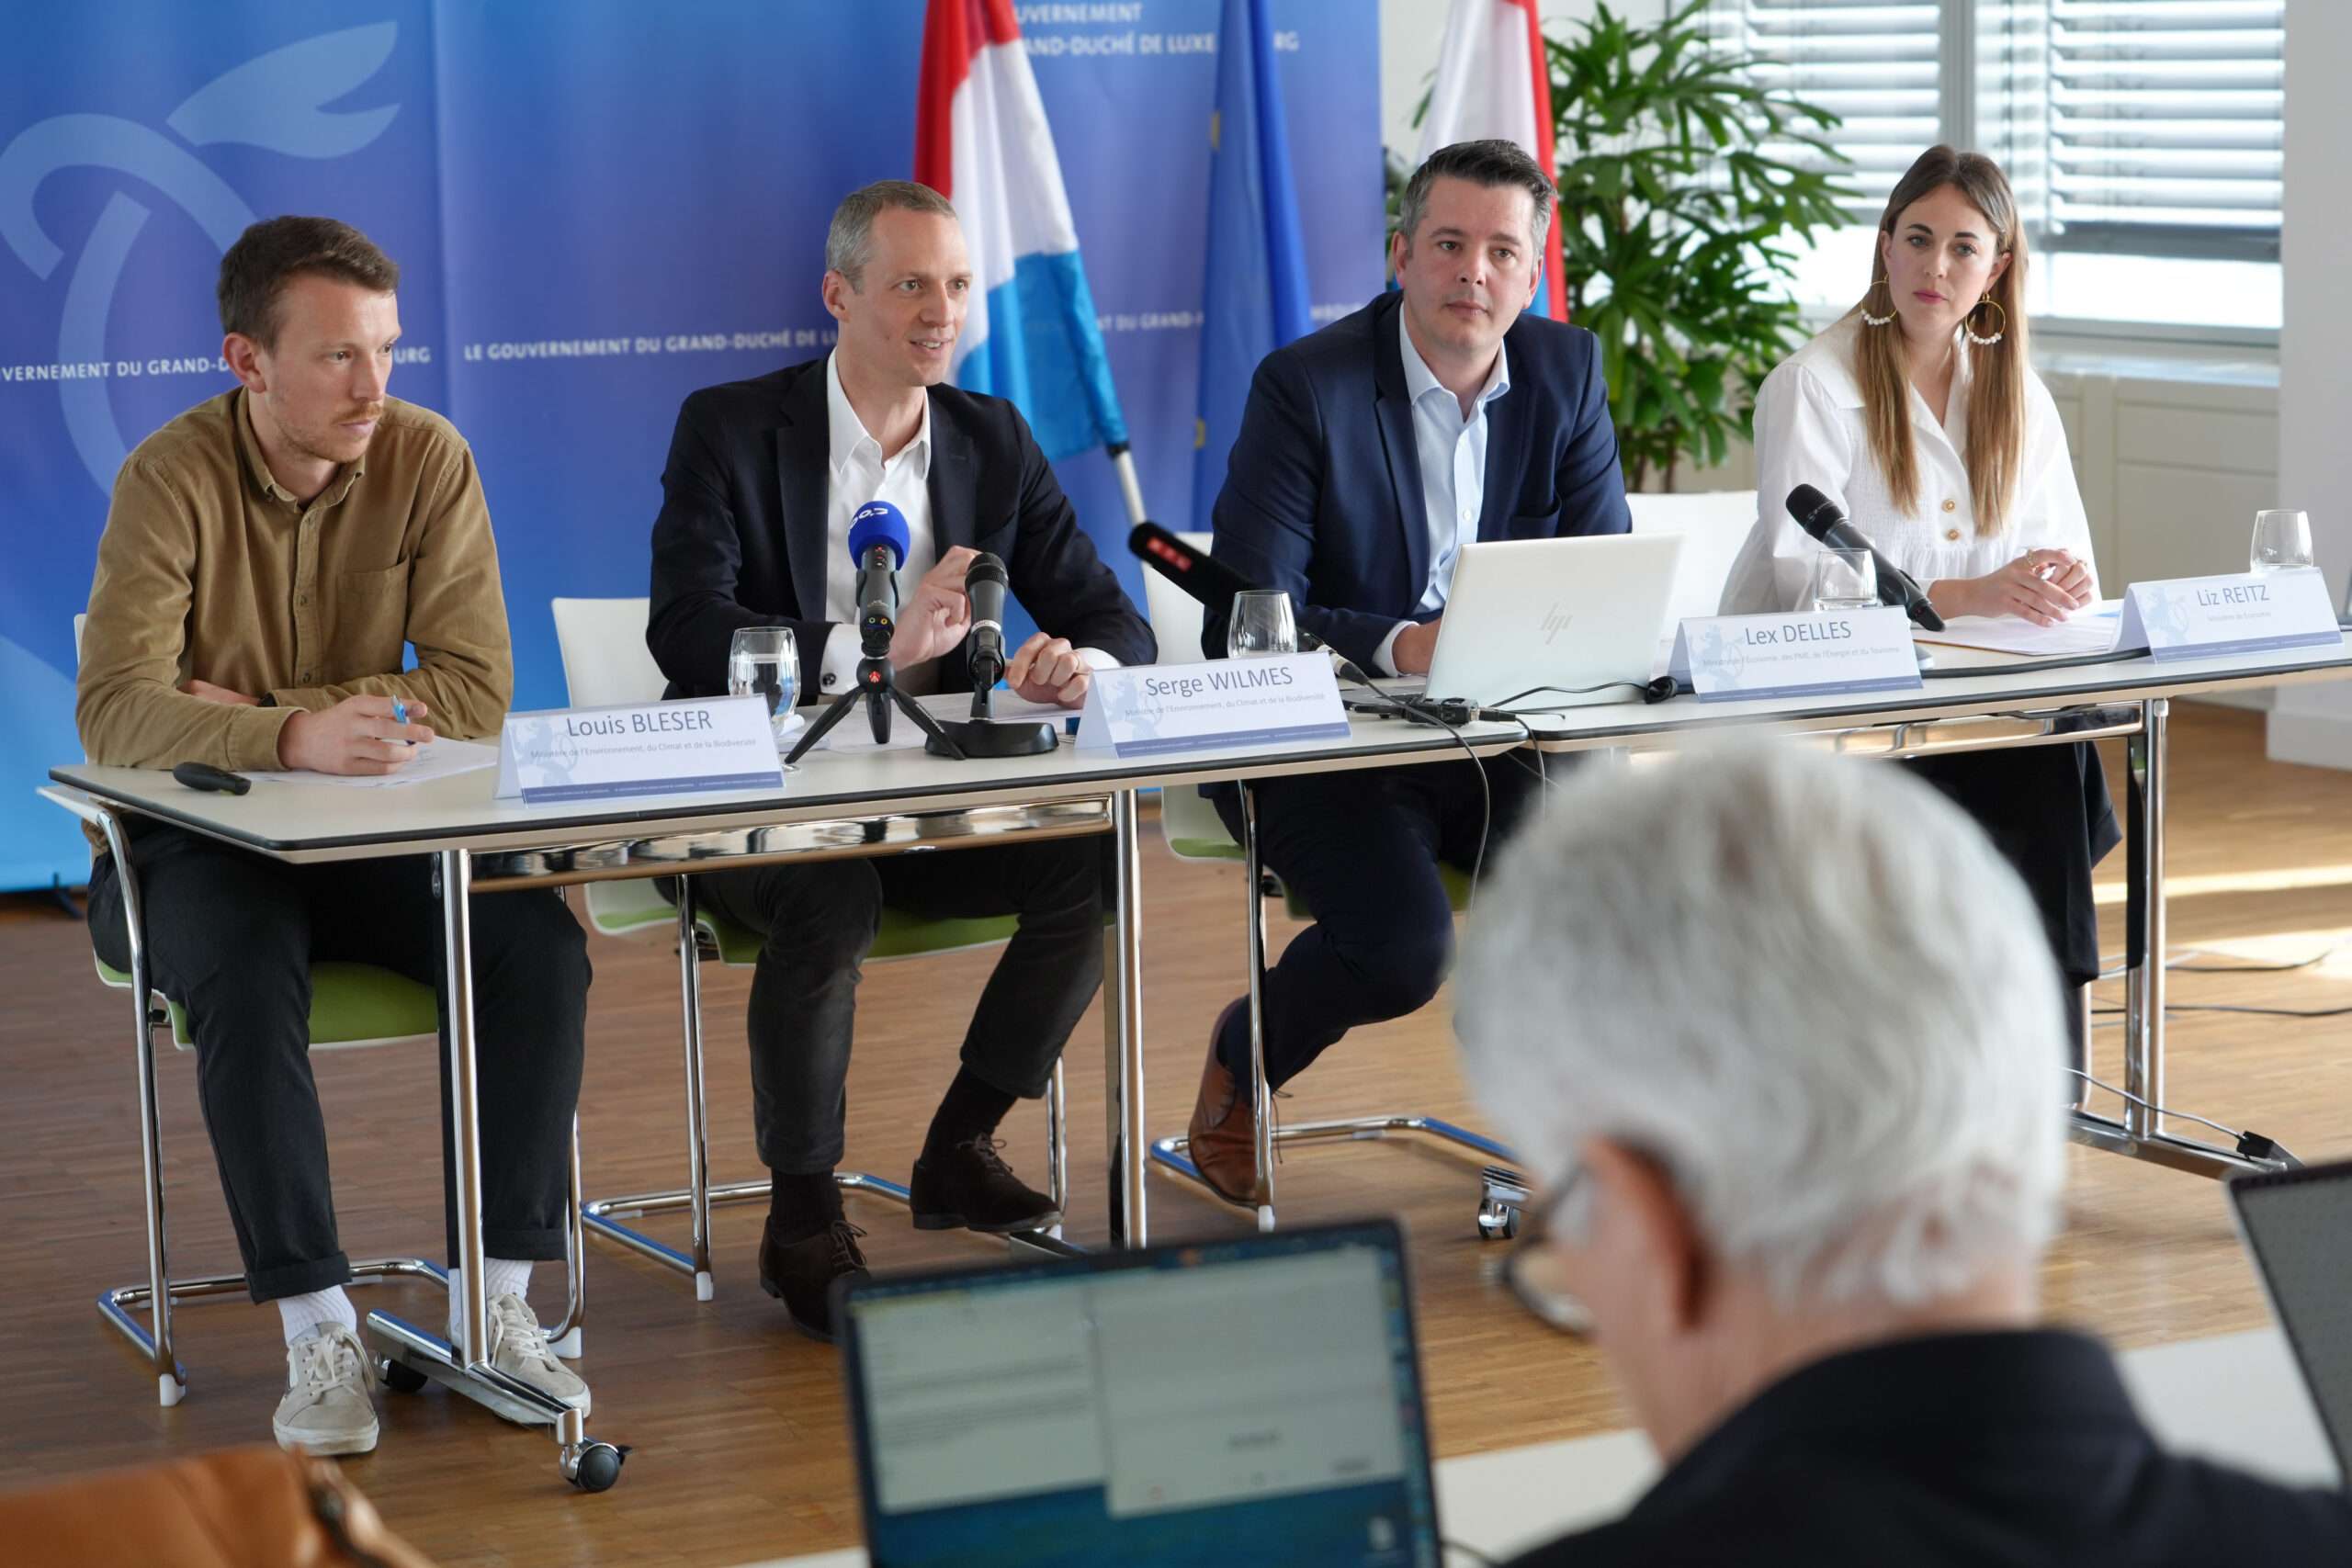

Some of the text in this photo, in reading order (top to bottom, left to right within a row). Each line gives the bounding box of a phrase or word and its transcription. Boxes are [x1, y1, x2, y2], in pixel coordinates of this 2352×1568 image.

[464, 344, 482, 360] LE
[487, 337, 630, 359] GOUVERNEMENT
[635, 336, 661, 354] DU
[665, 328, 790, 353] GRAND-DUCHÉ
[0, 362, 109, 382] VERNEMENT
[117, 360, 141, 378] DU
[2197, 584, 2270, 606] Liz REITZ
[1745, 621, 1852, 646] Lex DELLES
[1146, 667, 1294, 698] Serge WILMES
[566, 710, 713, 737] Louis BLESER
